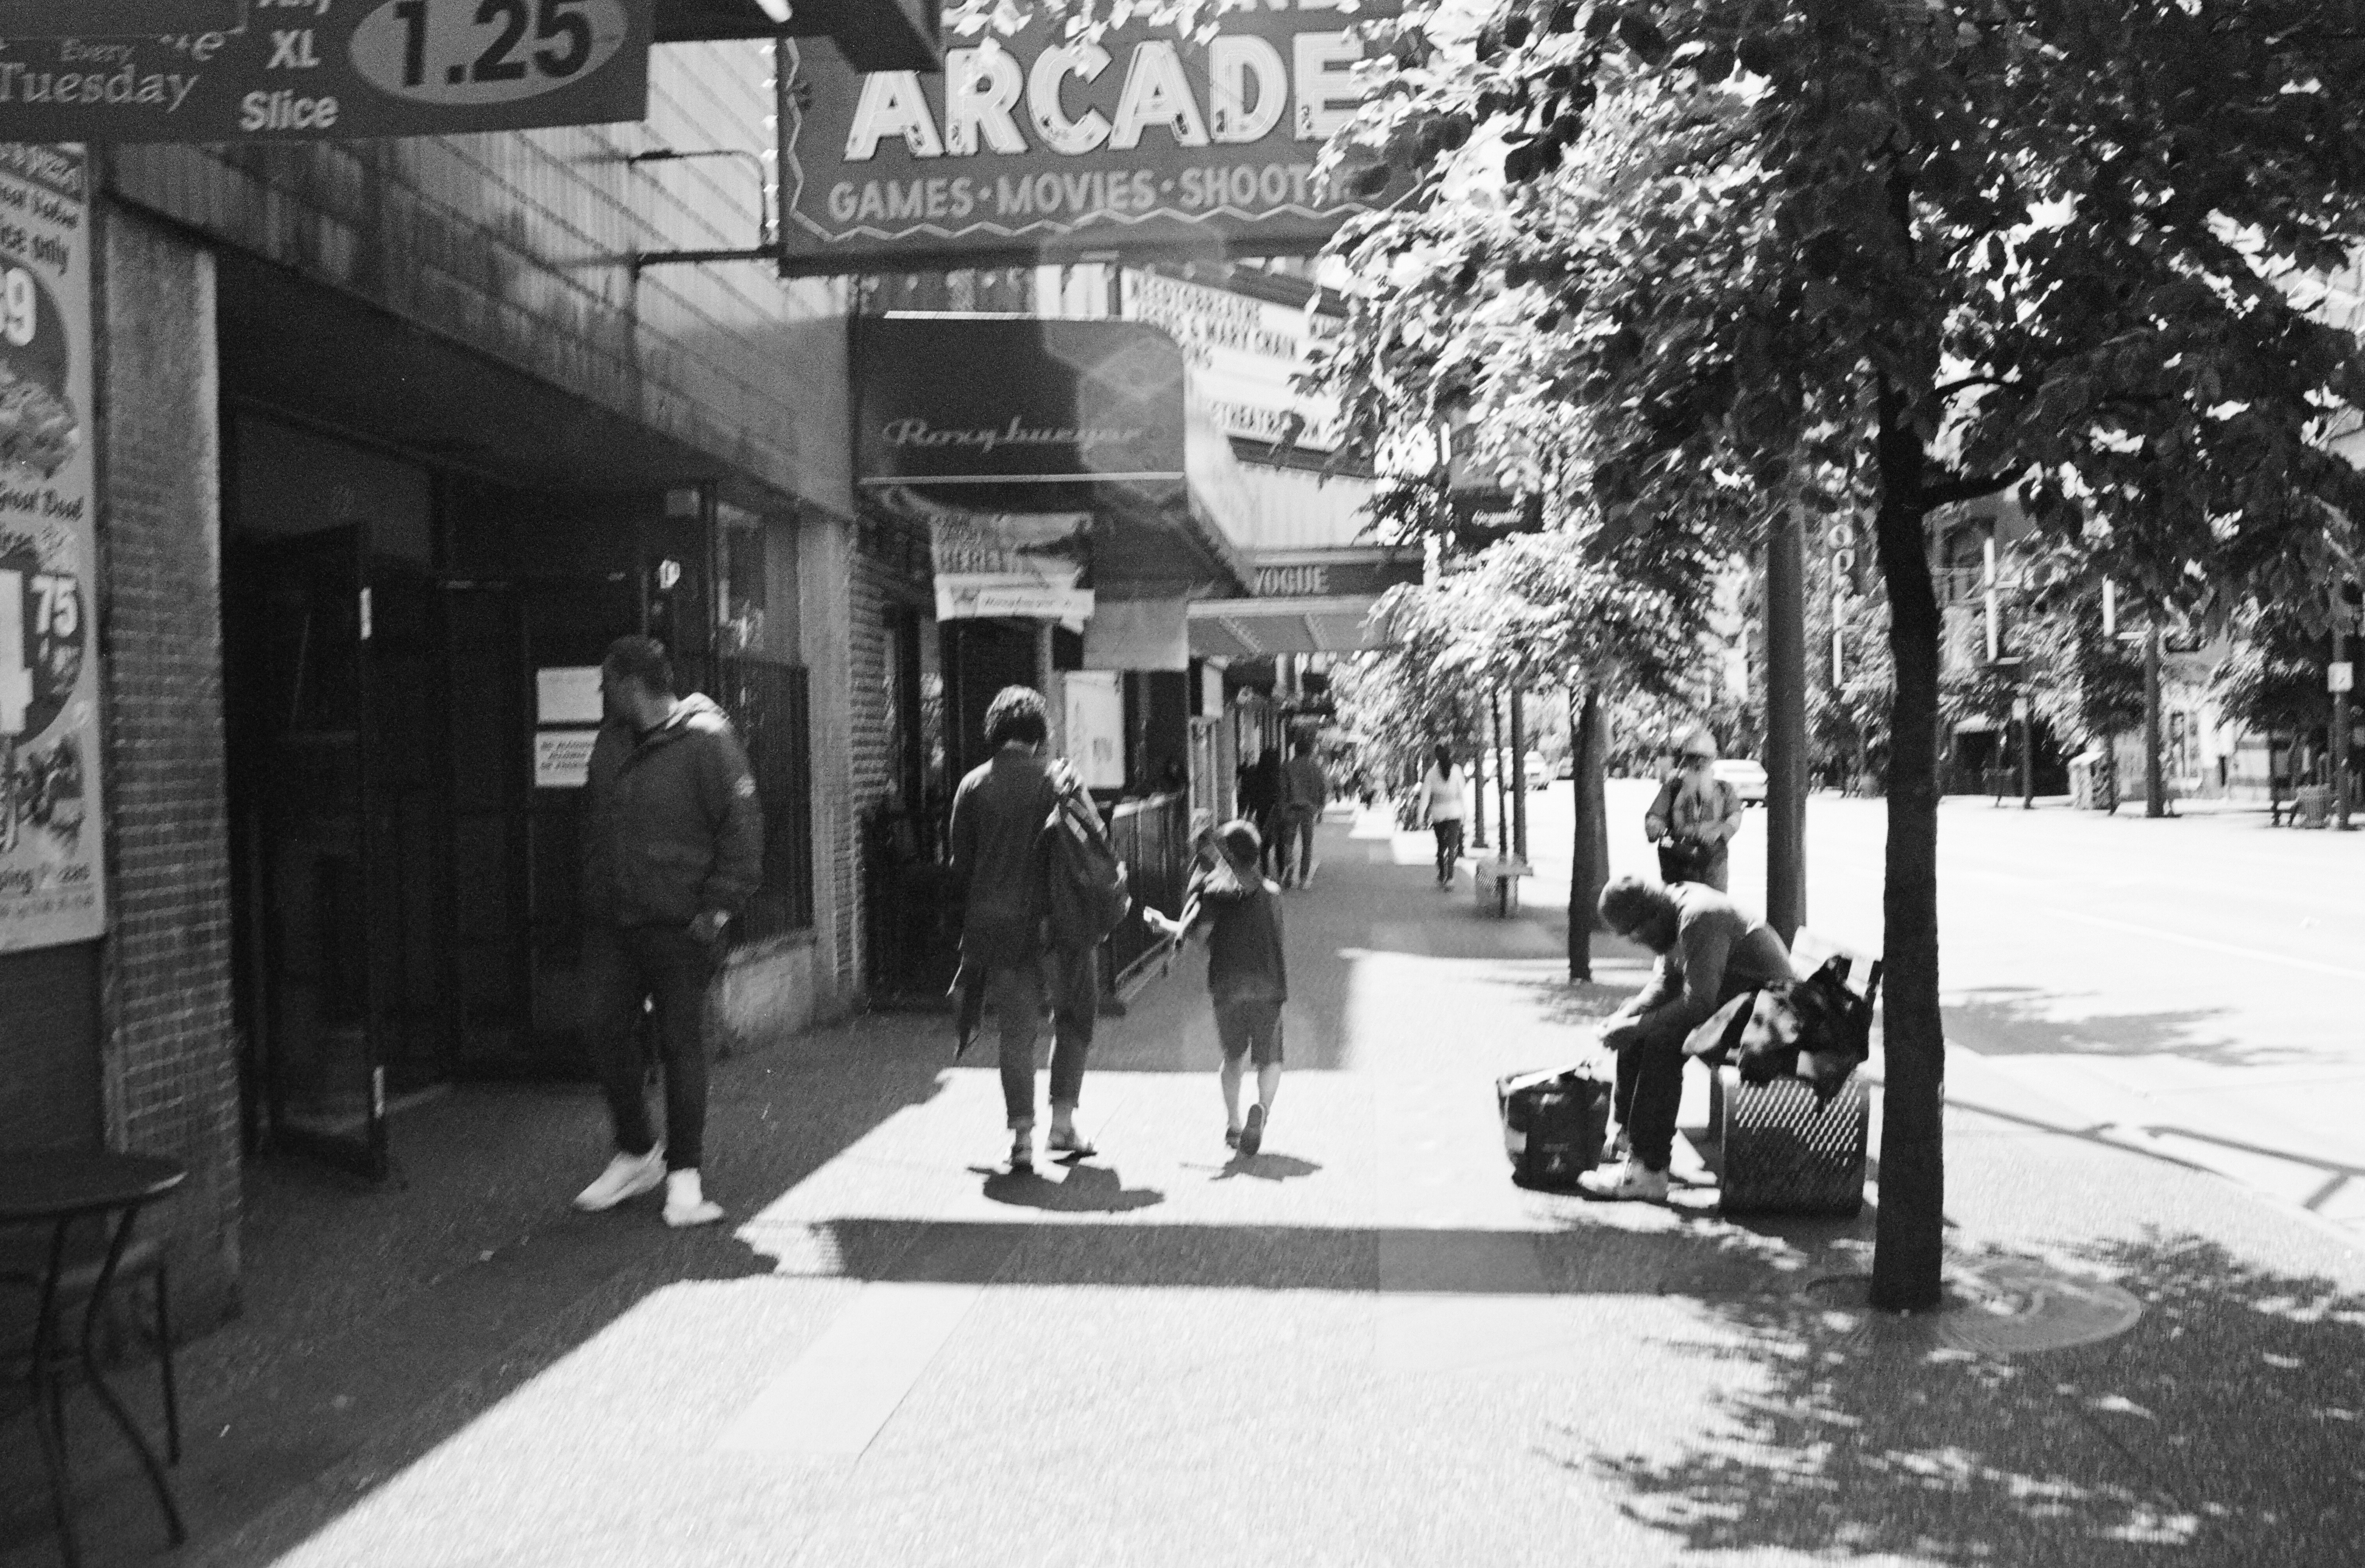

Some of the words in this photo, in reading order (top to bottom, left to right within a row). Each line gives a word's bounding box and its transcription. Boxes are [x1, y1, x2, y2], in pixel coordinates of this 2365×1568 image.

[267, 29, 321, 69] XL
[393, 0, 592, 88] 1.25
[0, 63, 200, 113] Tuesday
[239, 89, 339, 131] Slice
[844, 33, 1369, 161] ARCADE
[828, 176, 972, 224] GAMES
[996, 169, 1156, 216] MOVIES
[1252, 565, 1330, 595] VOGUE
